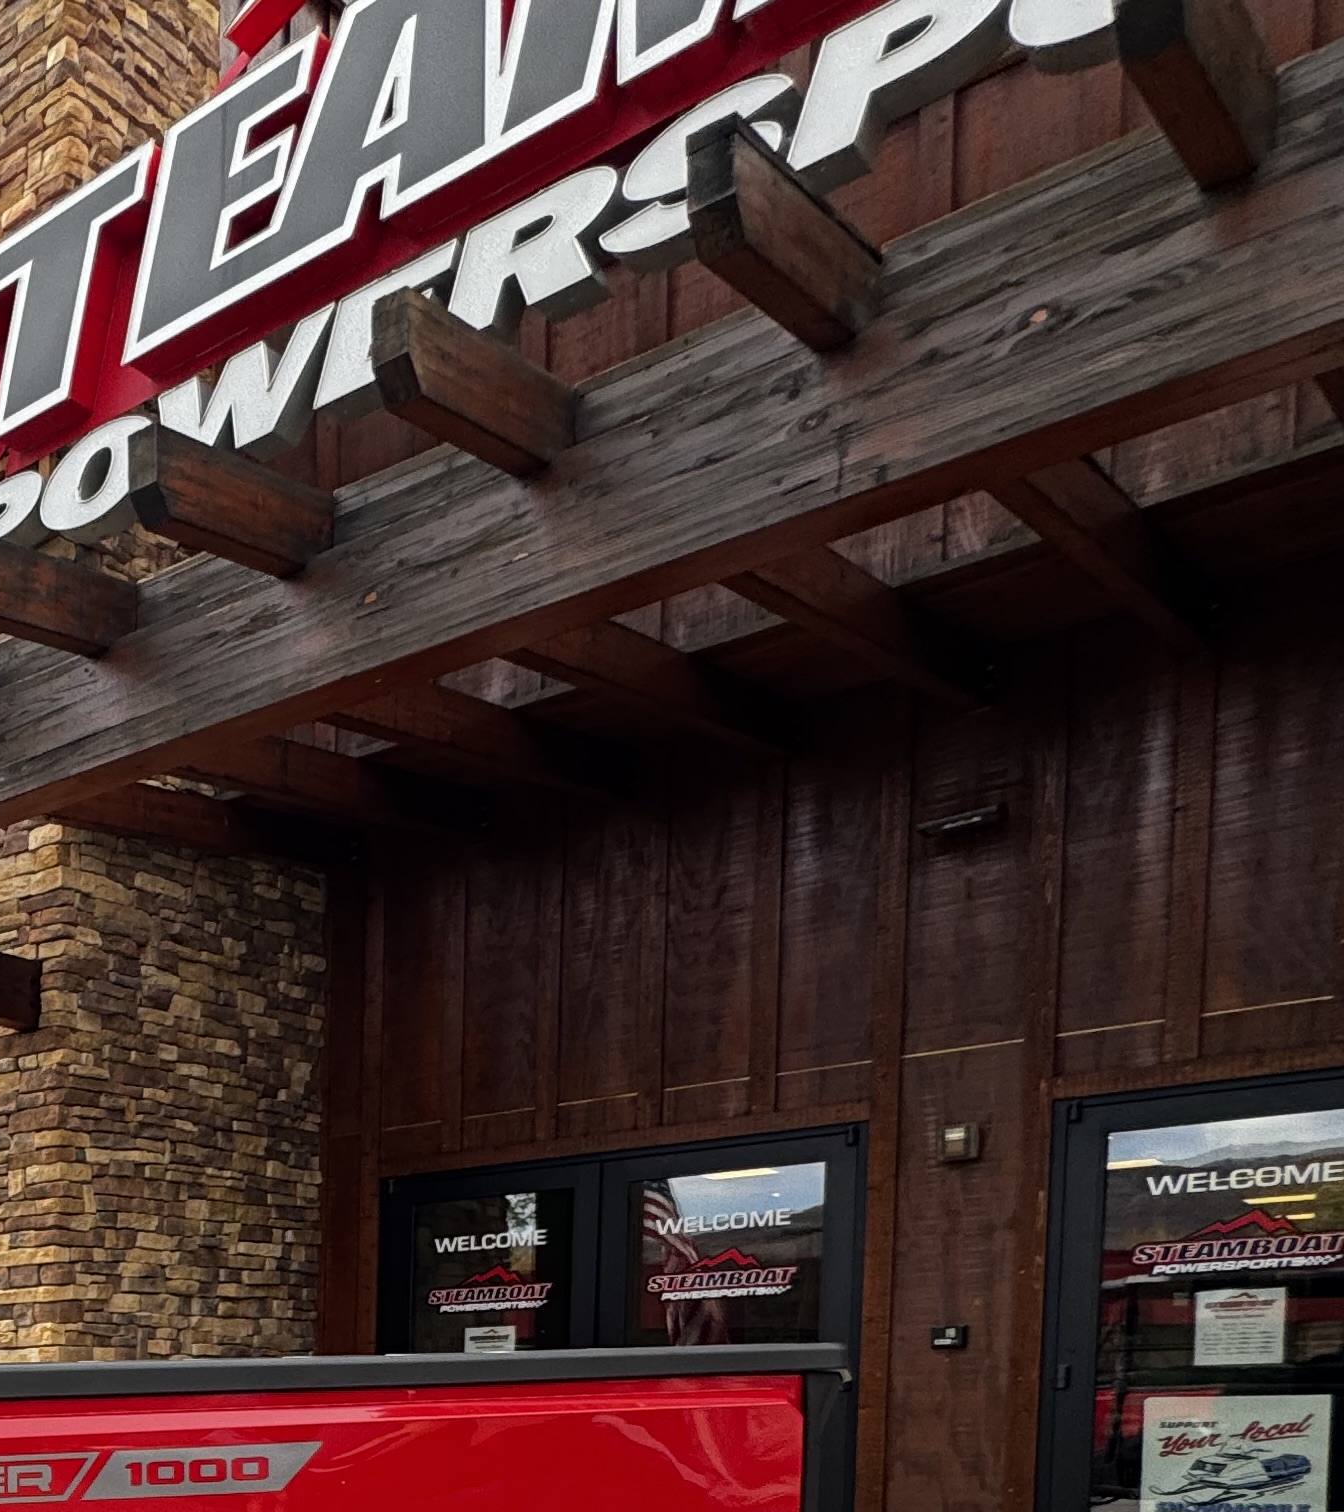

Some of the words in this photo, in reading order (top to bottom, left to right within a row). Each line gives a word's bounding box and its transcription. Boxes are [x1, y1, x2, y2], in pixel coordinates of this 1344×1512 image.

[1146, 1160, 1344, 1196] WELCOME
[656, 1207, 792, 1235] WELCOME
[434, 1229, 548, 1254] WELCOME
[1132, 1232, 1344, 1265] STEAMBOAT
[647, 1266, 798, 1293] STEAMBOAT
[1152, 1258, 1306, 1275] POWERSPORTS
[428, 1283, 552, 1305] STEAMBOAT
[124, 1455, 271, 1487] 1000
